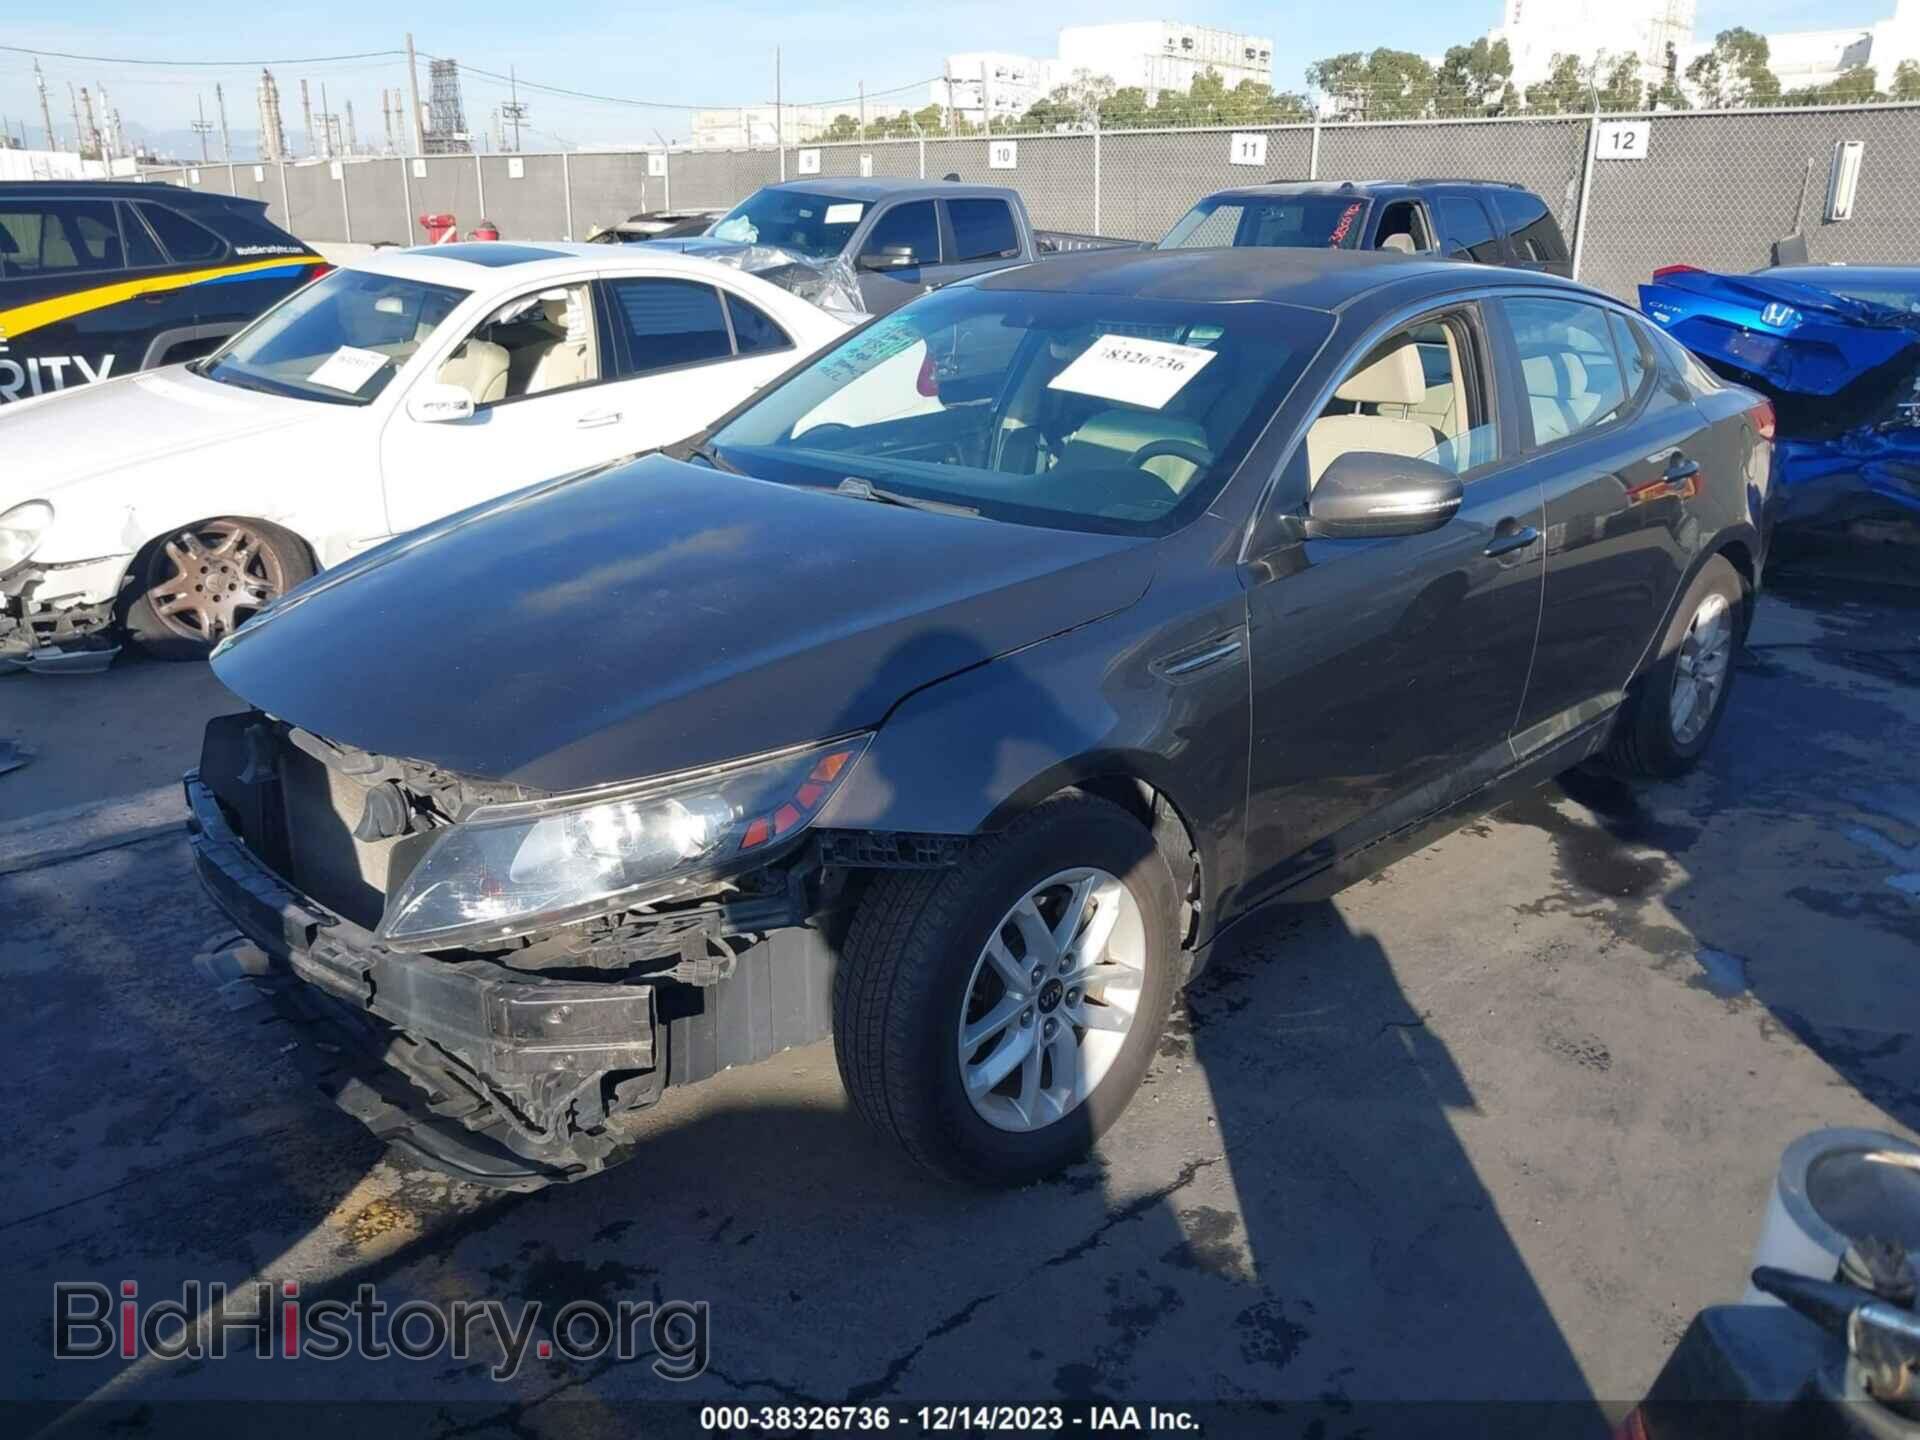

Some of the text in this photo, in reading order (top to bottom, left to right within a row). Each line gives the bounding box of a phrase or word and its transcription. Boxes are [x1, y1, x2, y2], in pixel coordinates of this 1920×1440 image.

[1612, 131, 1636, 149] 12
[997, 148, 1010, 162] 10
[1241, 142, 1257, 157] 11
